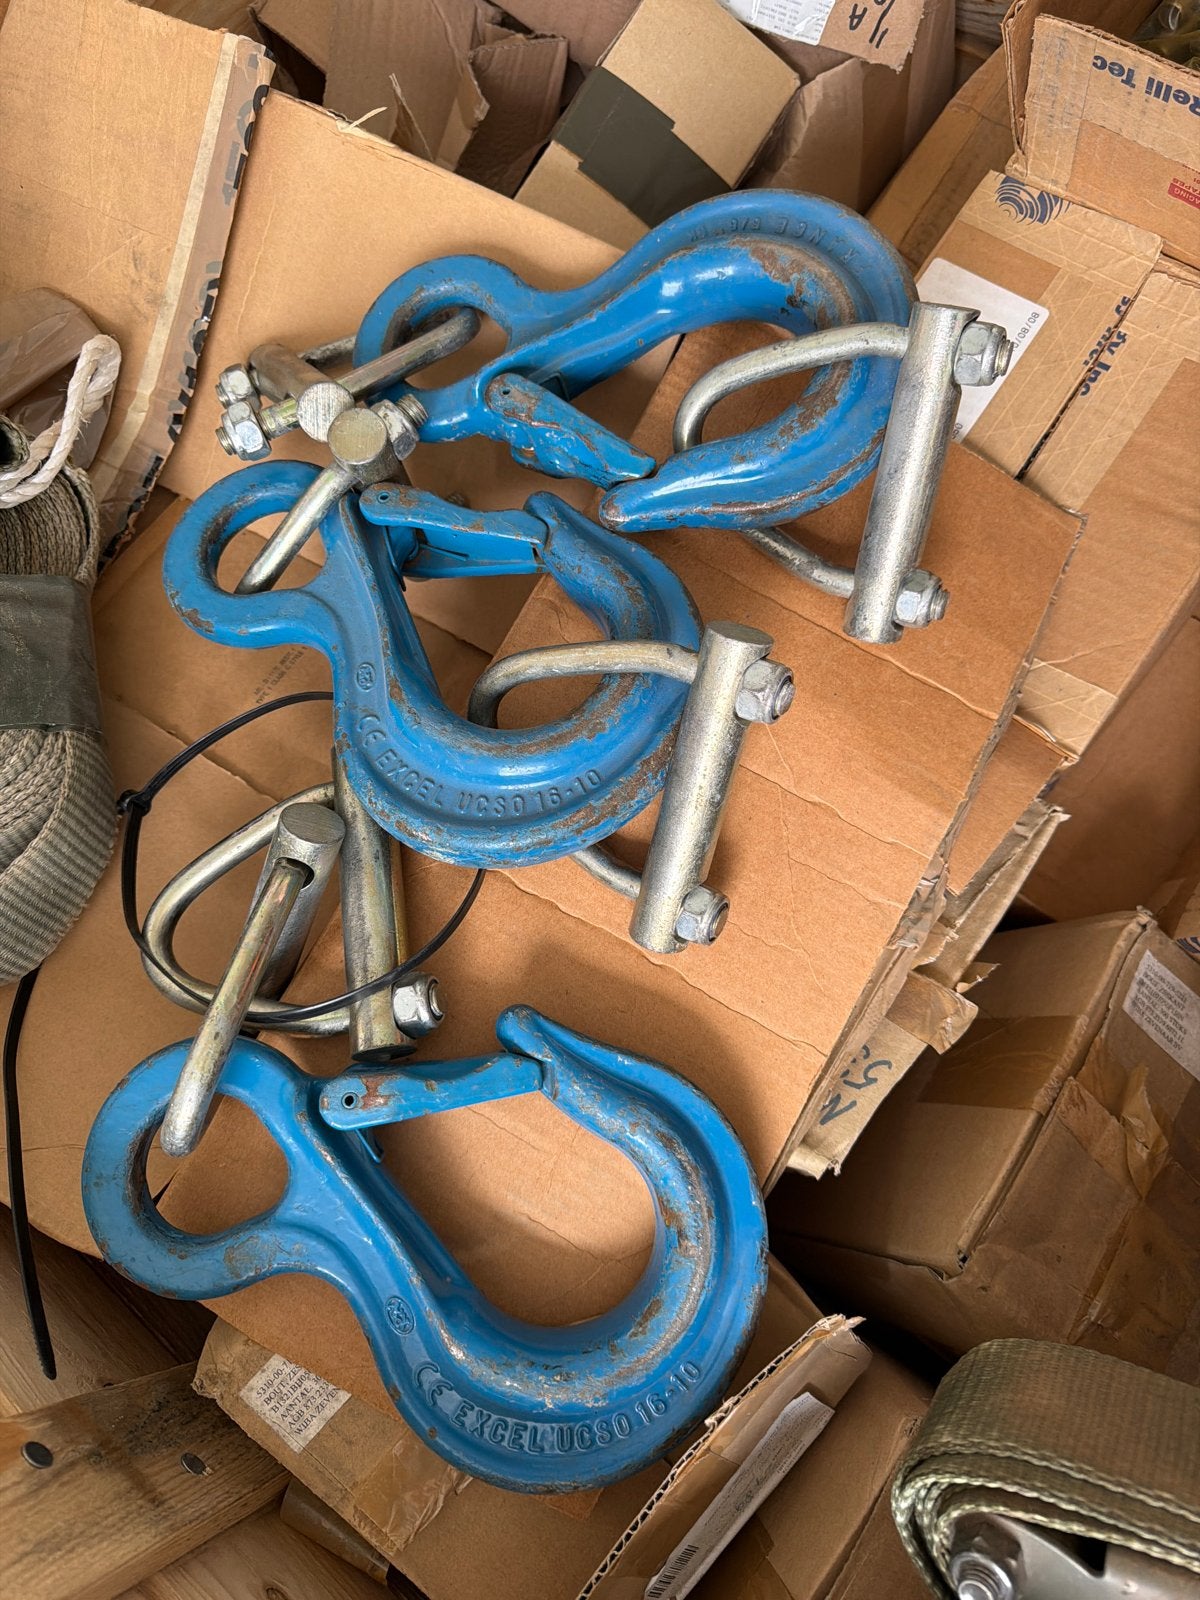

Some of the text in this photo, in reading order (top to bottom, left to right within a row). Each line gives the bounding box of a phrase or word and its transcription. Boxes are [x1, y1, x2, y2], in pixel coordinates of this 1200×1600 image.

[849, 4, 868, 30] A
[1092, 55, 1136, 89] Tec
[375, 749, 445, 809] EXCEL
[271, 1369, 312, 1414] B1321BH05
[450, 1401, 545, 1455] EXCEL
[634, 1360, 700, 1425] 16-10
[288, 1410, 305, 1429] AGB
